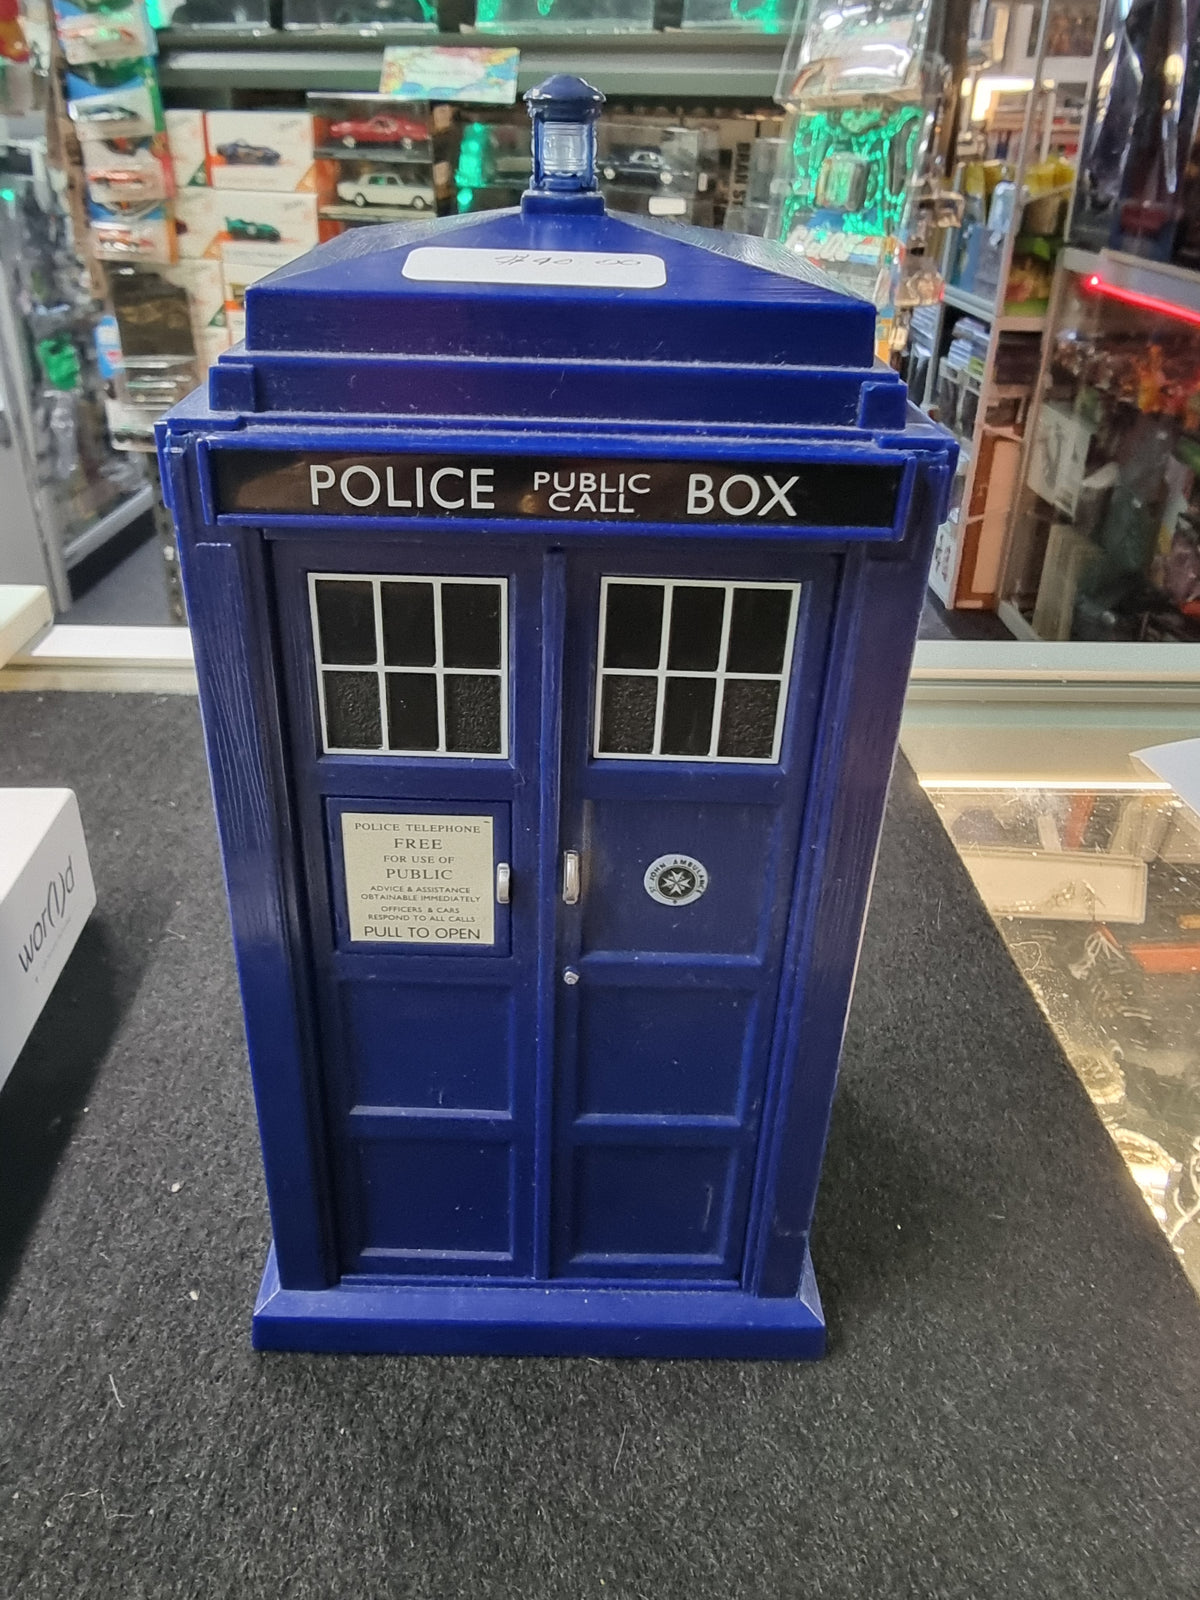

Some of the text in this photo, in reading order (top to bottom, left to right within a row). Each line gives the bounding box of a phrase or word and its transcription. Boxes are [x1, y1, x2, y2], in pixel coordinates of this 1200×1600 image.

[309, 464, 800, 517] POLICE PUBLIC CALL BOX
[354, 822, 481, 834] POLICE TELEPHONE
[394, 838, 443, 850] FREE
[383, 855, 455, 864] FOR USE OF
[386, 868, 454, 880] PUBLIC
[649, 862, 667, 882] JOHN
[370, 885, 404, 893] ADVICE
[415, 886, 471, 894] ASSISTANCE
[360, 893, 481, 903] OBTAINABLE IMMEDIATELY
[448, 915, 476, 923] CALLS
[364, 925, 481, 940] PULL TO OPEN
